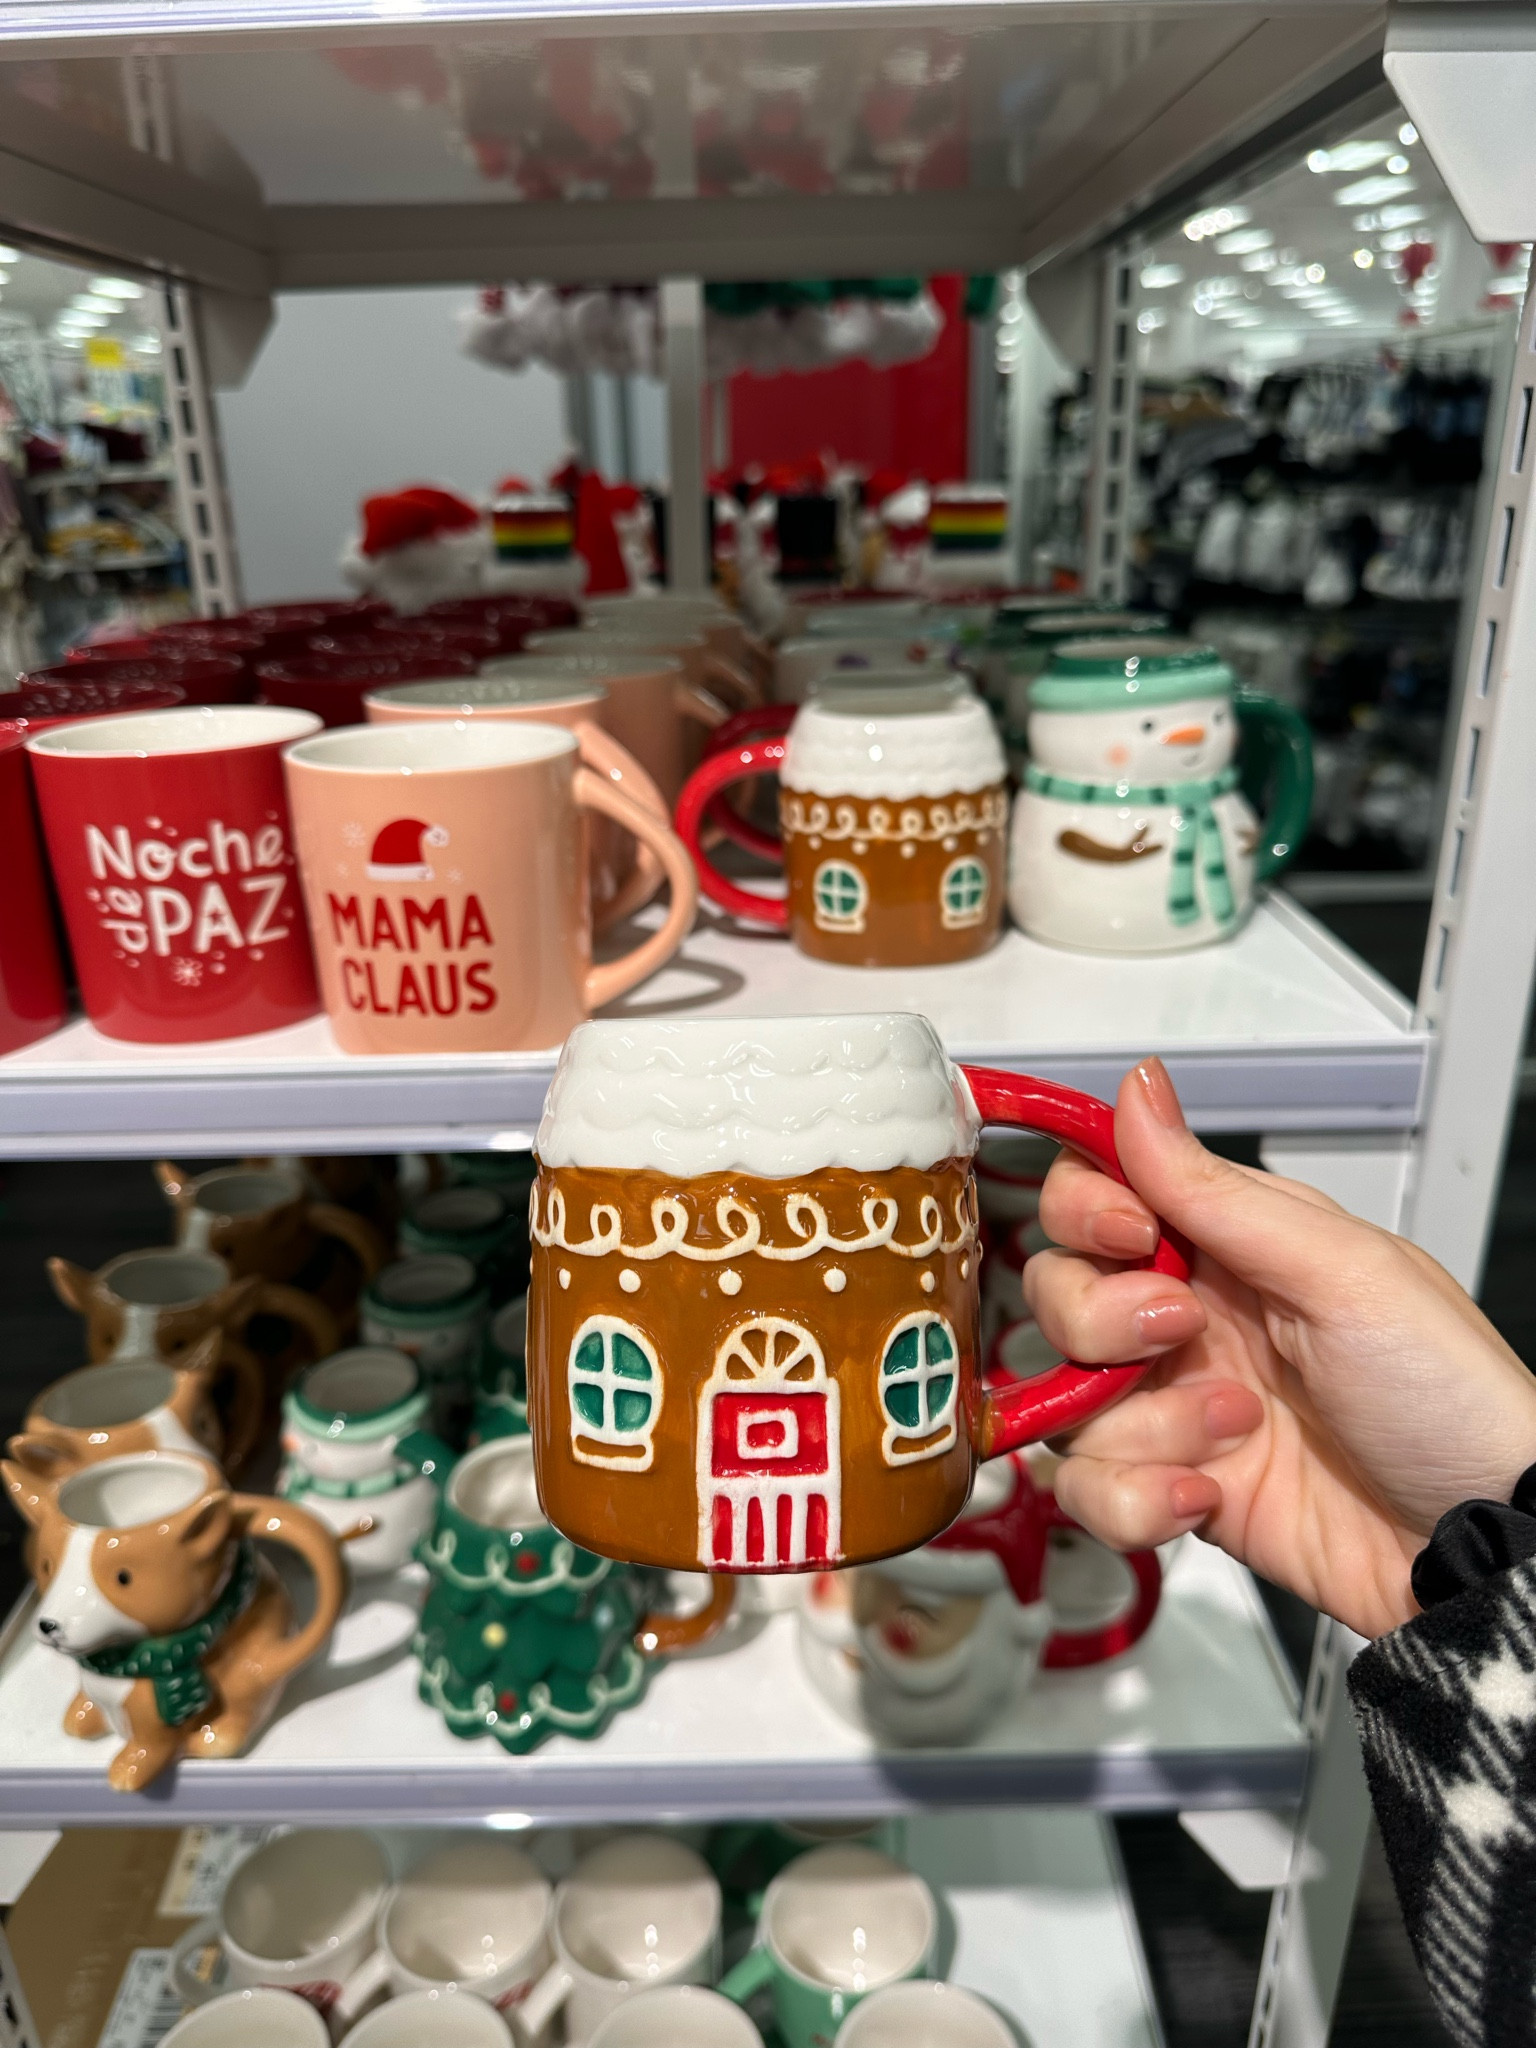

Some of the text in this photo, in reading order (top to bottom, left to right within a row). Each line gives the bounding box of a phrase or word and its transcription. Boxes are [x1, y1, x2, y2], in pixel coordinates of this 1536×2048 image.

[85, 819, 285, 882] Noche
[102, 873, 289, 957] de PAZ
[328, 890, 493, 951] MAMA
[342, 957, 497, 1016] CLAUS
